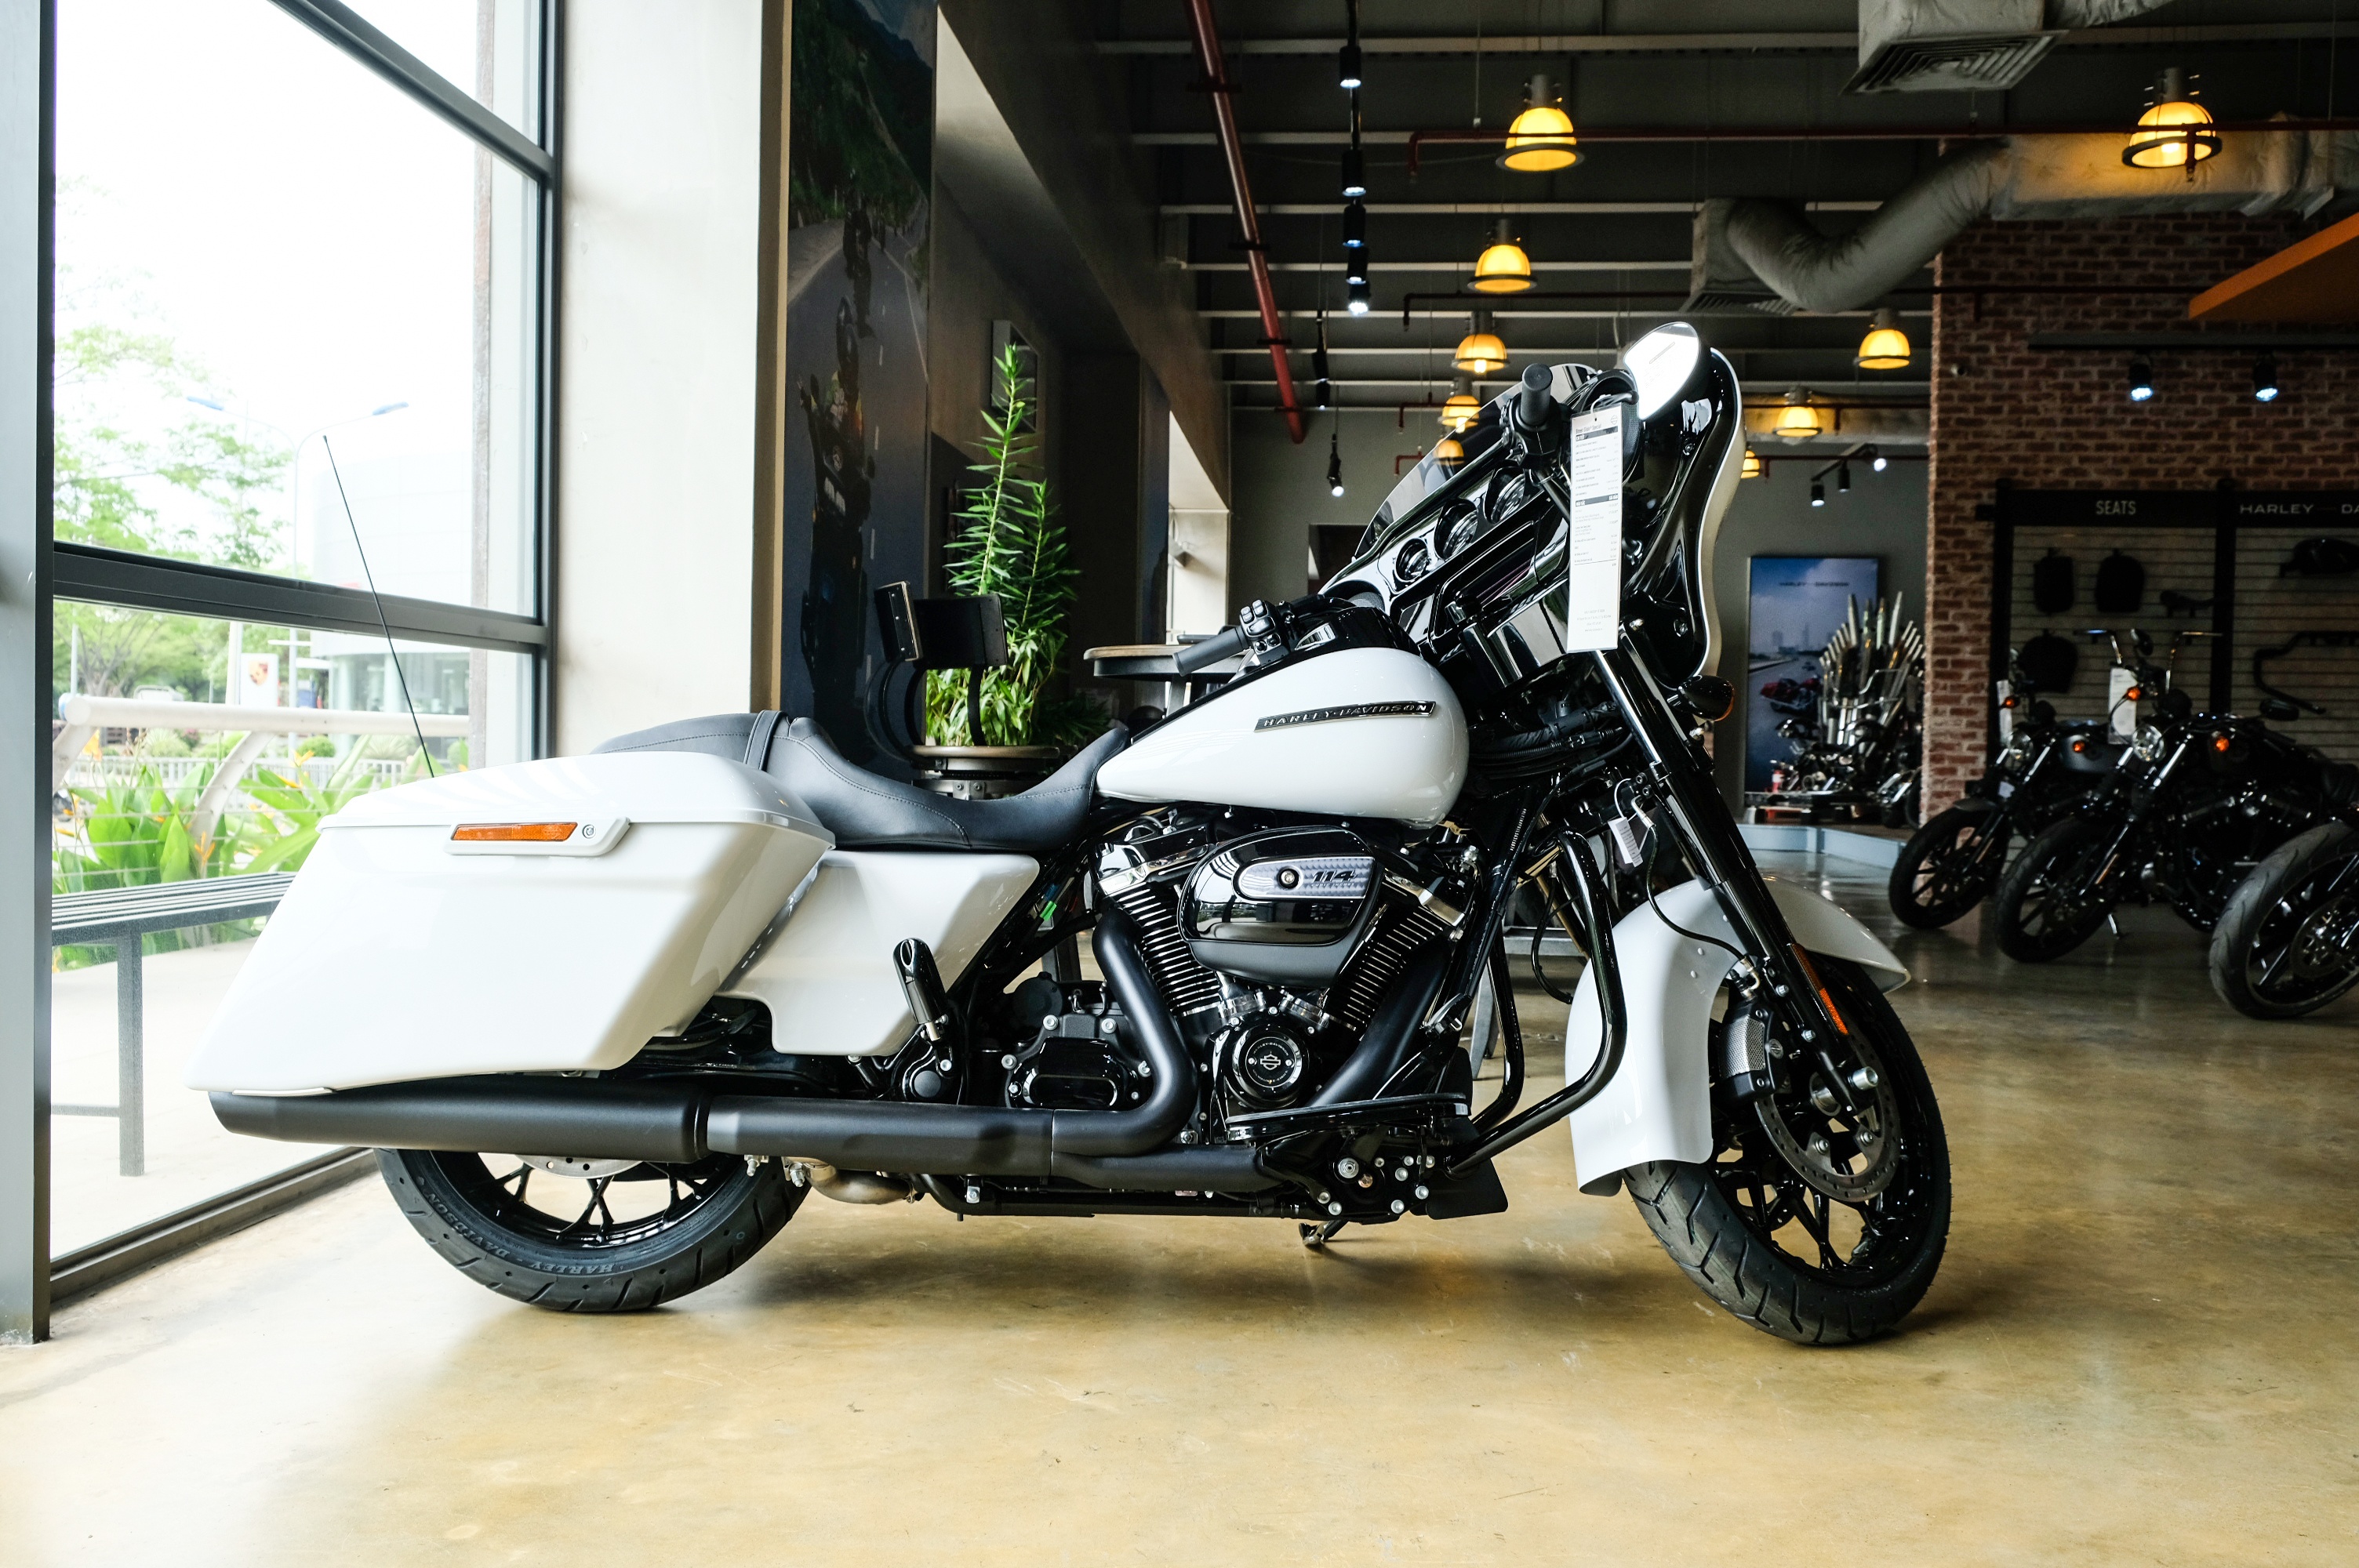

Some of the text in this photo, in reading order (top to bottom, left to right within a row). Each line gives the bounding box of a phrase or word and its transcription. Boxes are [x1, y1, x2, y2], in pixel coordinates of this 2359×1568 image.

[2095, 499, 2136, 515] SEATS
[2240, 503, 2314, 514] HARLEY
[1313, 869, 1358, 883] 114
